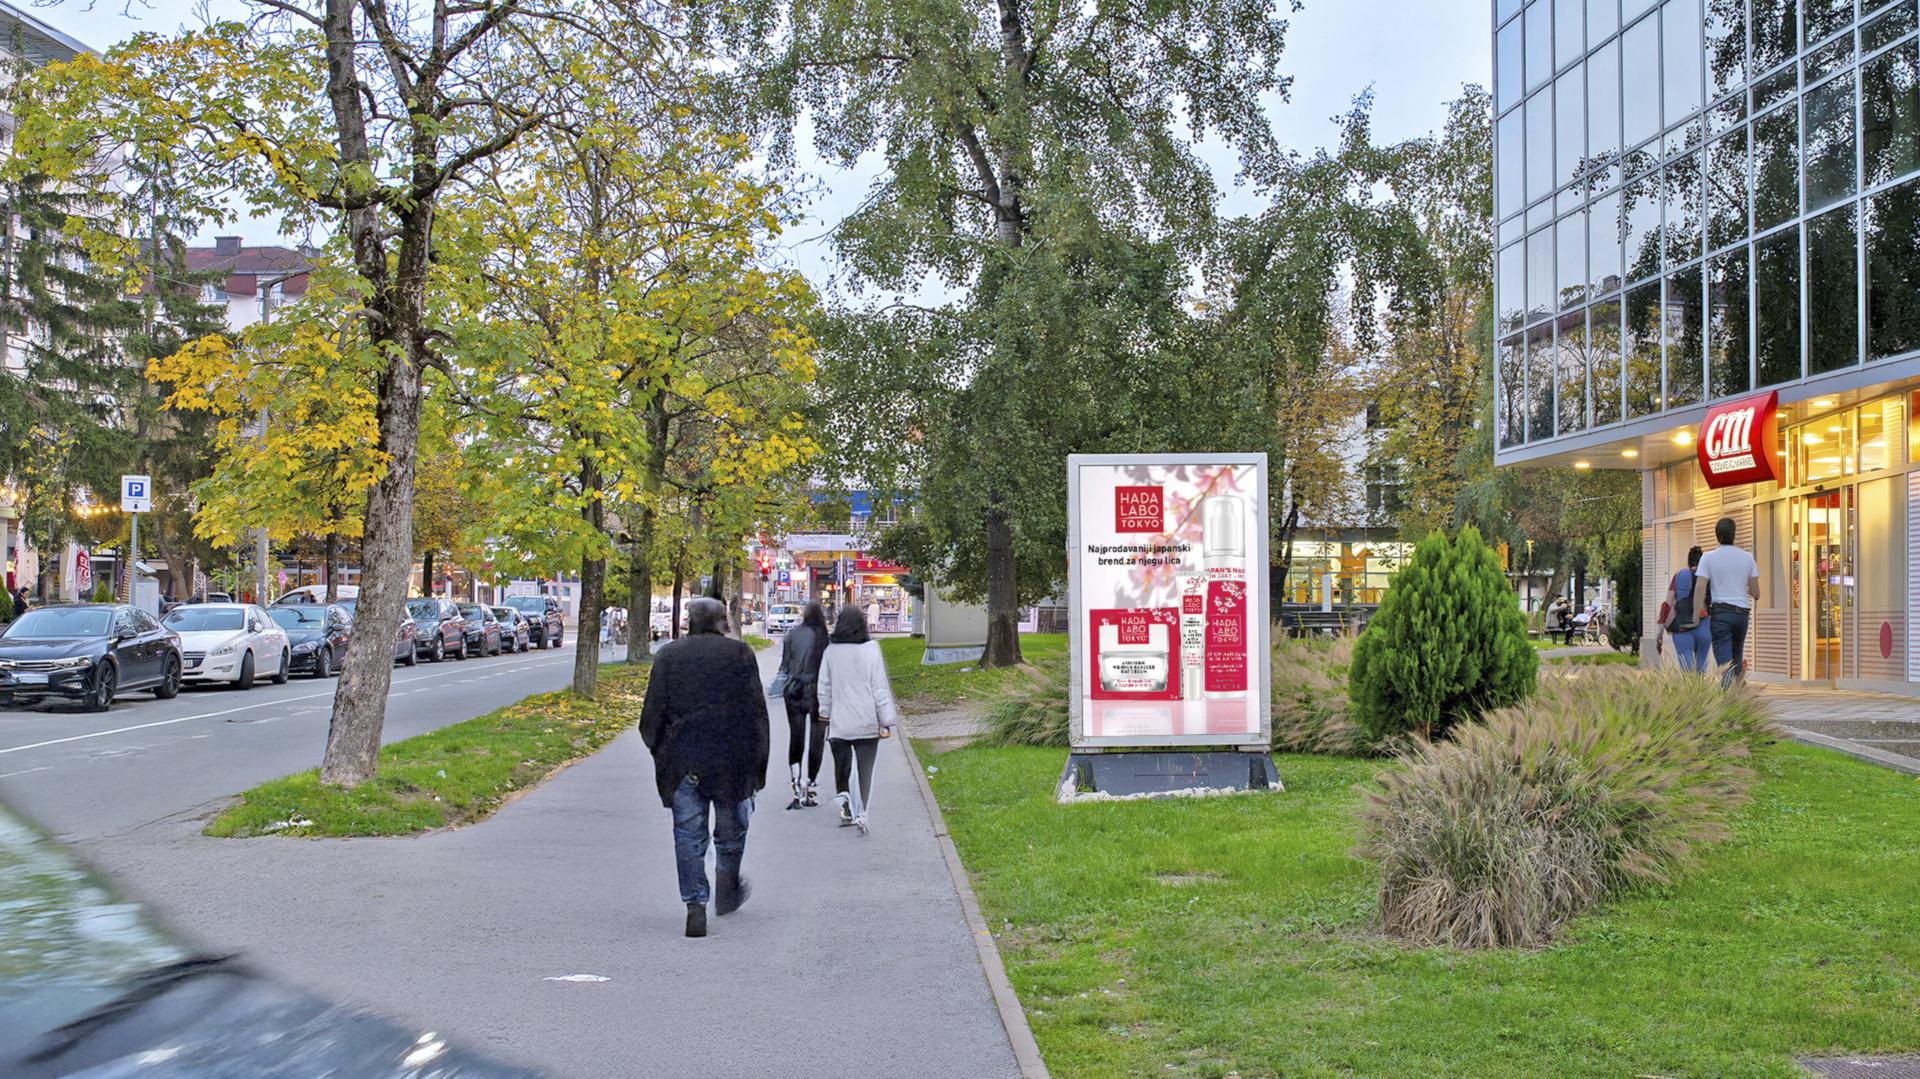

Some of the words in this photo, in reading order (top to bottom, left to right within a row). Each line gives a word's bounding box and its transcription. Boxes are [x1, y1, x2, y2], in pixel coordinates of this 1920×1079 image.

[132, 484, 141, 495] P
[1120, 492, 1159, 504] HADA
[1120, 505, 1159, 516] LABO
[1121, 519, 1160, 528] TOKYO
[1088, 544, 1152, 555] Najprodavaniji
[1153, 544, 1191, 555] japanski
[1098, 557, 1124, 565] brend
[1138, 558, 1163, 567] njegu
[1165, 557, 1181, 565] lica
[1121, 616, 1146, 625] HADA
[1212, 618, 1238, 627] HADA
[1121, 625, 1146, 634] LABO
